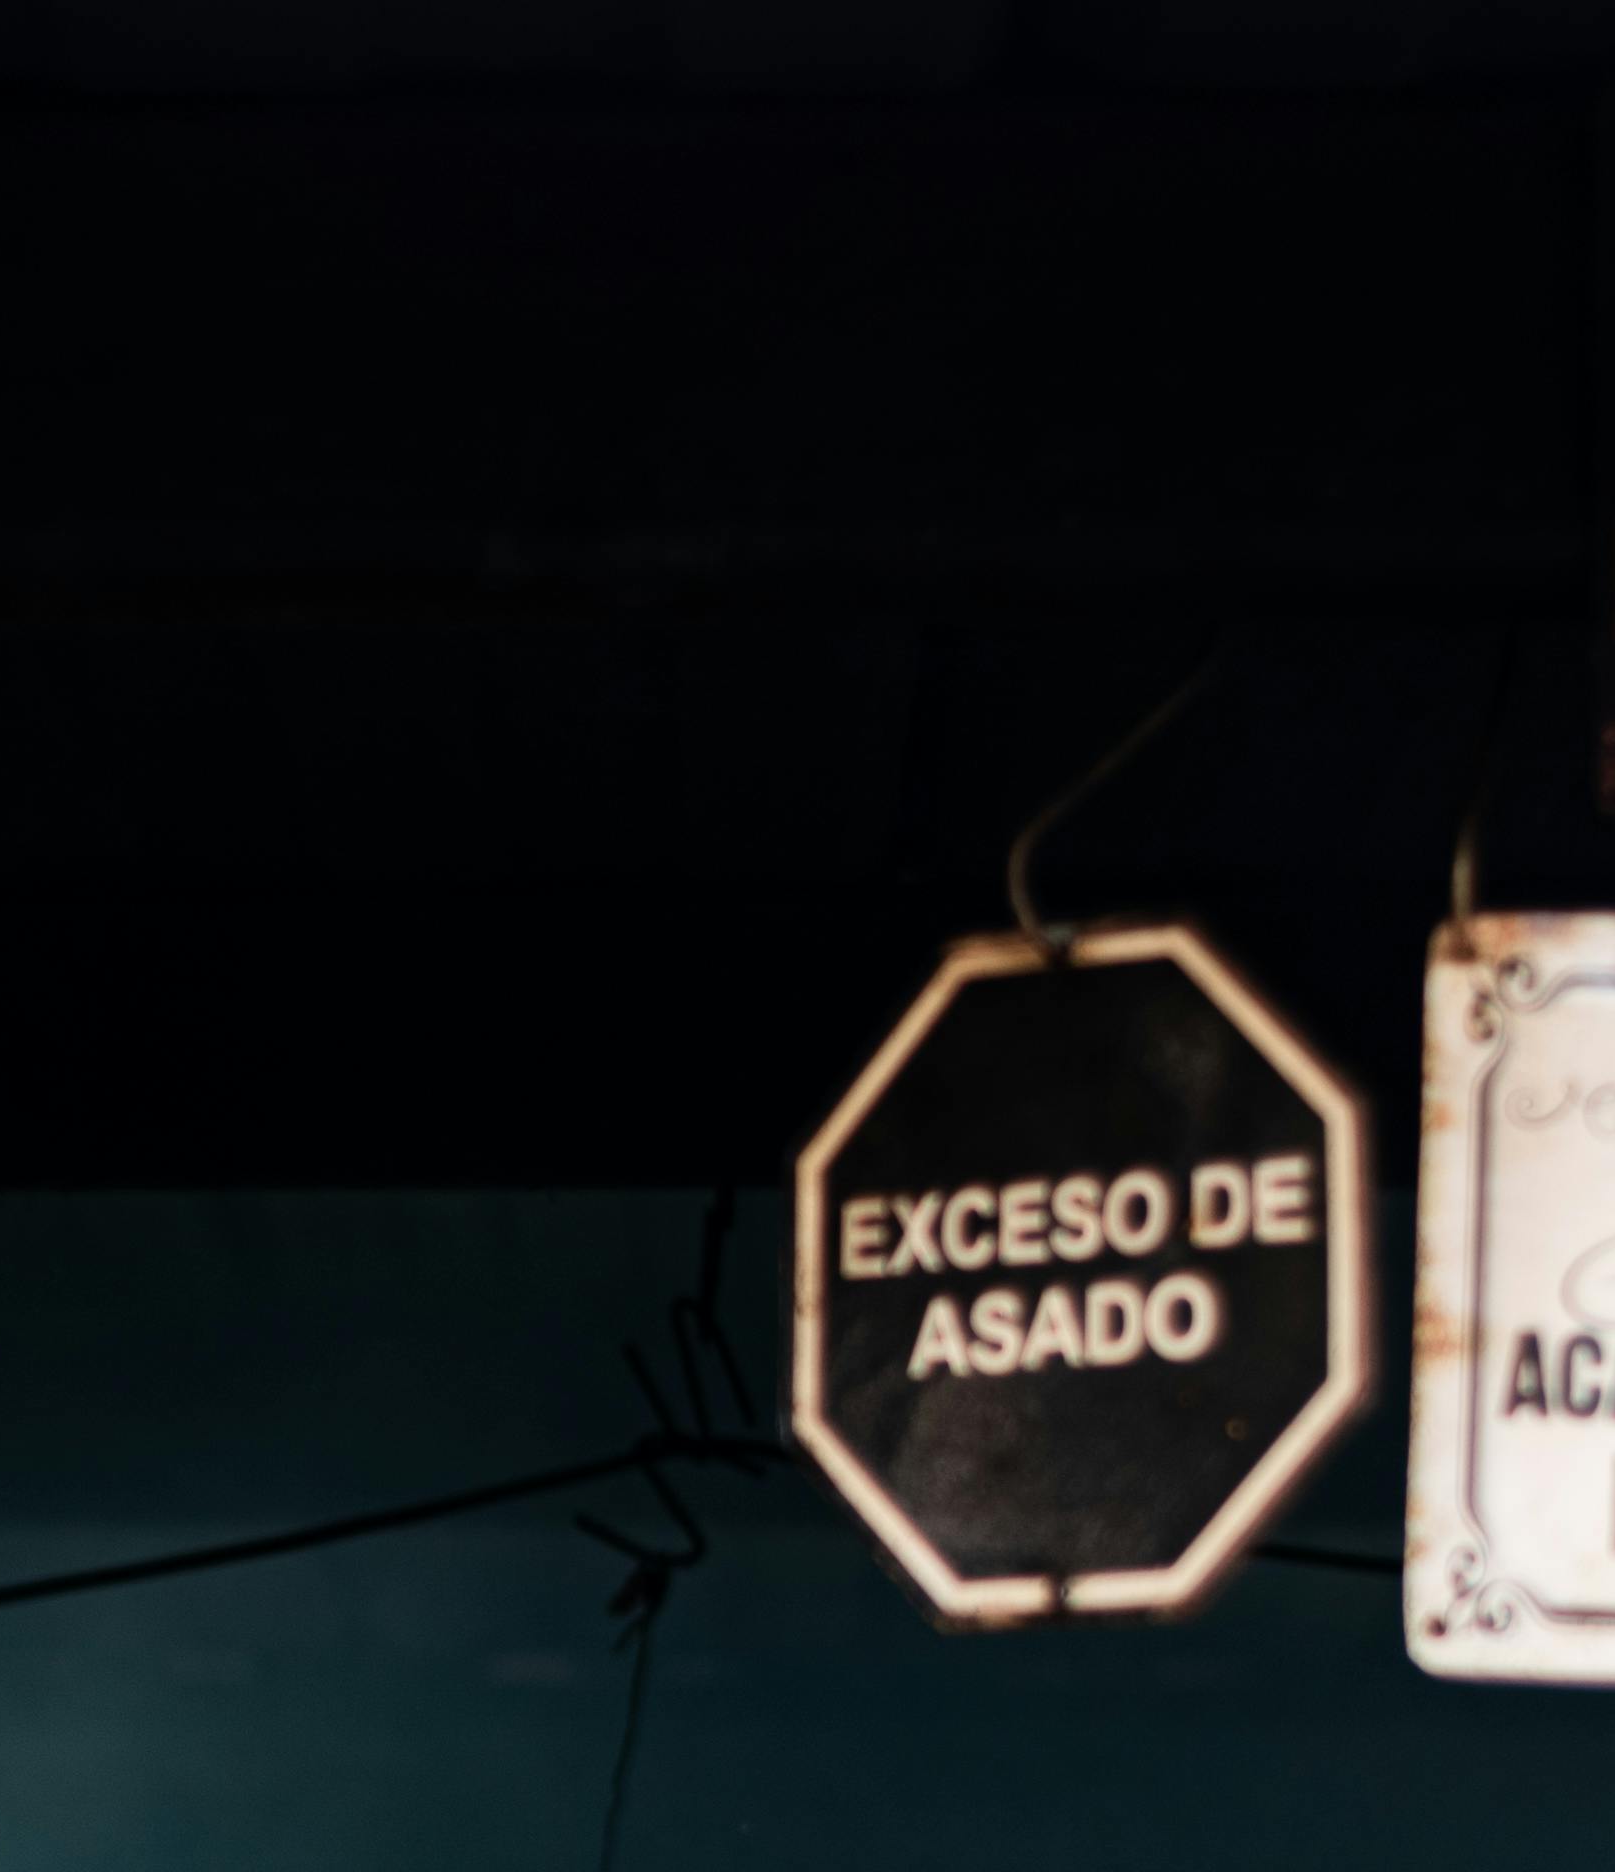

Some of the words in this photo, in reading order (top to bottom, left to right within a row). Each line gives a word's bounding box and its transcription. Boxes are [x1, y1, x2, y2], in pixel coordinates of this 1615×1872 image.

[838, 1167, 1175, 1281] EXCESO
[1188, 1154, 1316, 1250] DE
[907, 1270, 1225, 1381] ASADO
